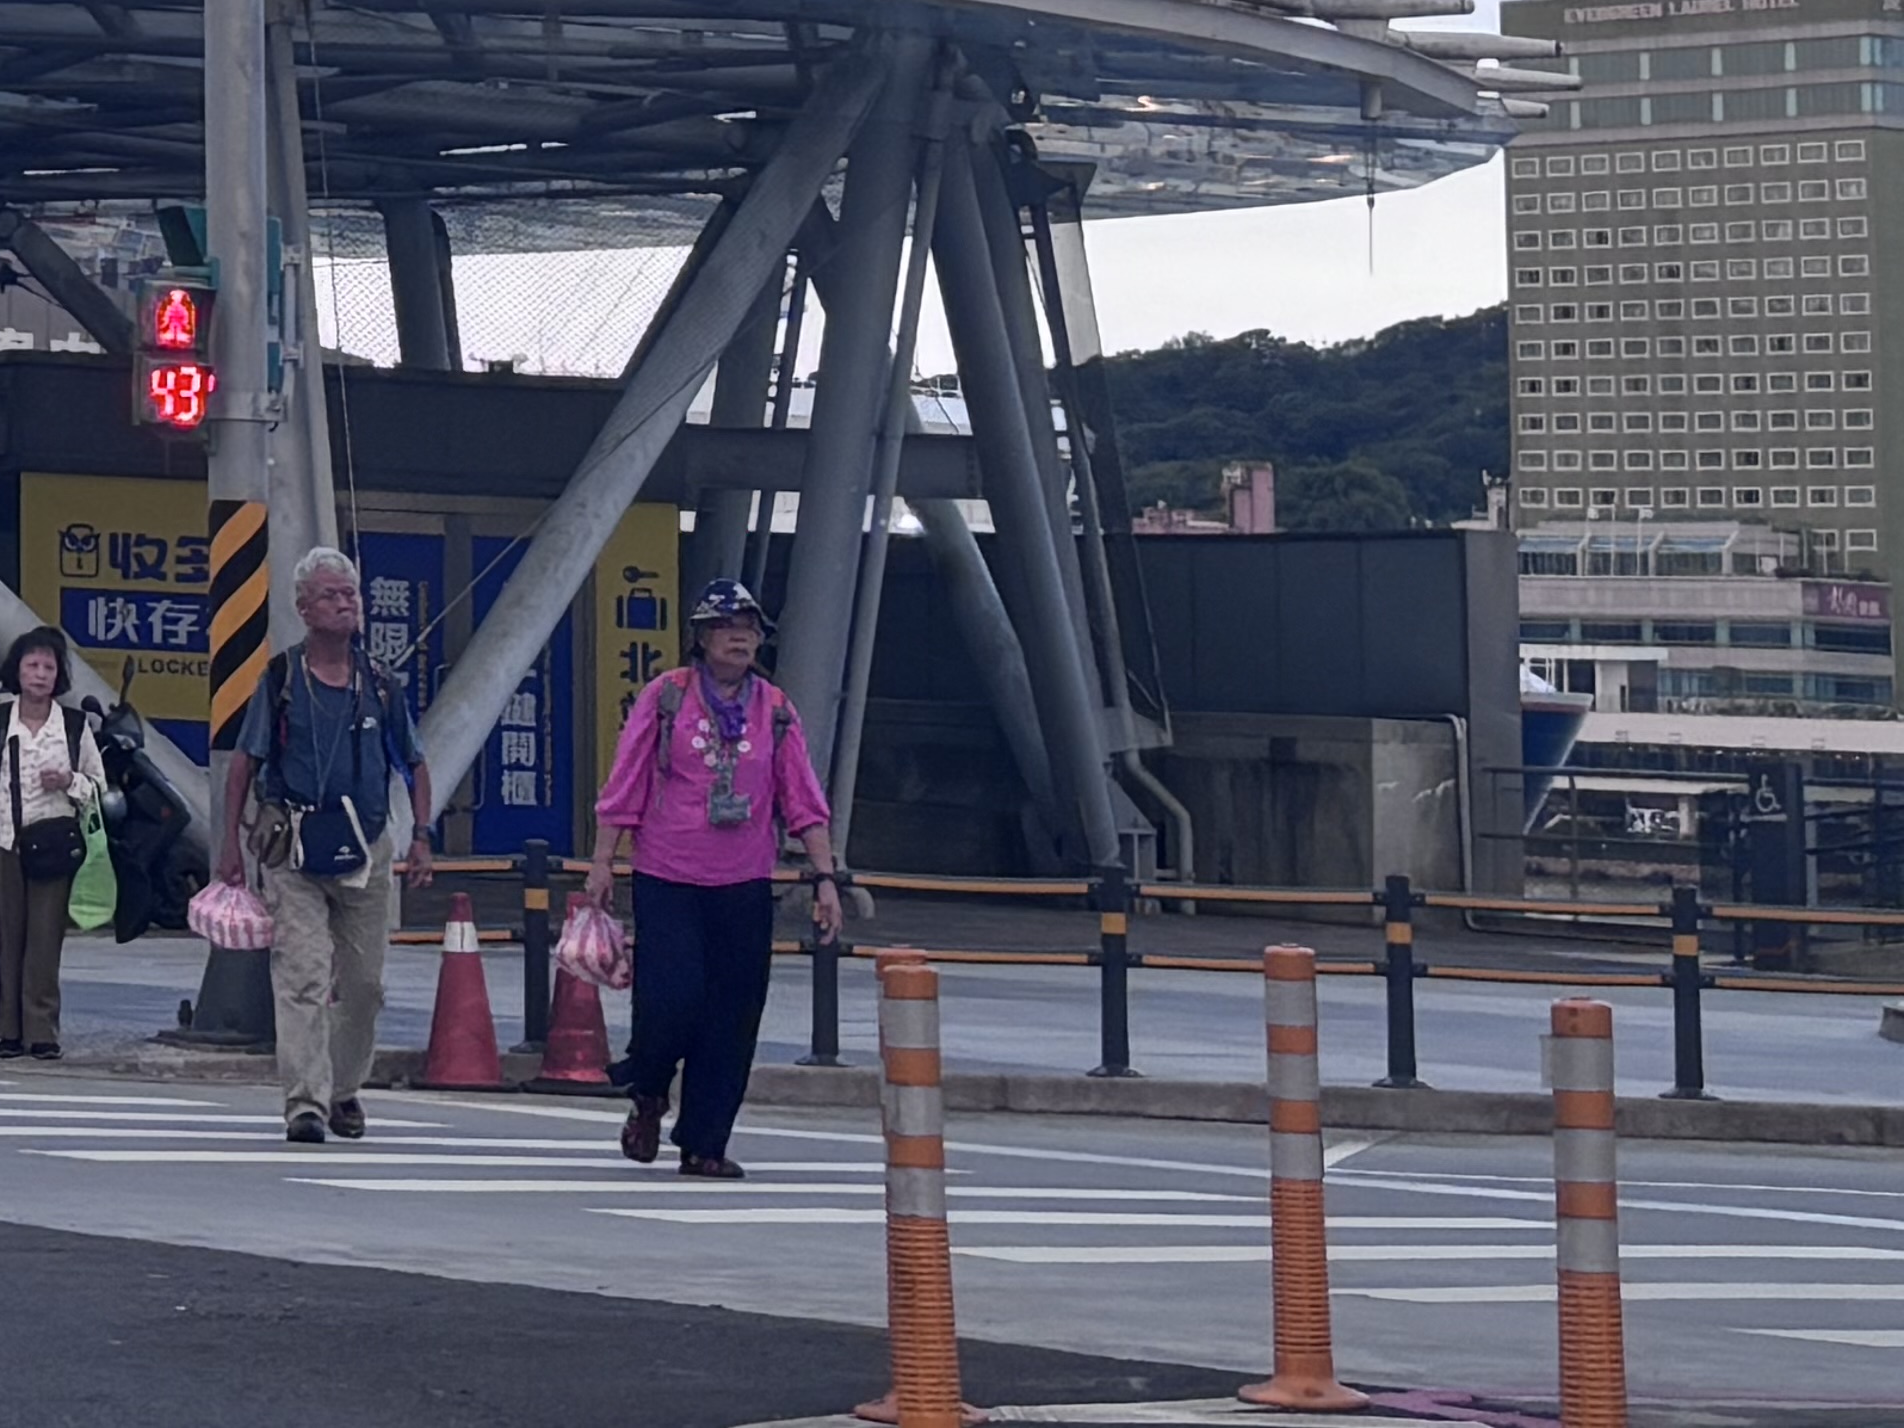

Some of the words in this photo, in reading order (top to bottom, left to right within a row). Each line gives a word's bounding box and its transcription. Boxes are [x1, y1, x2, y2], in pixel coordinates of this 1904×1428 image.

[150, 366, 201, 422] 43
[88, 596, 210, 645] 快存
[369, 576, 410, 687] 無限
